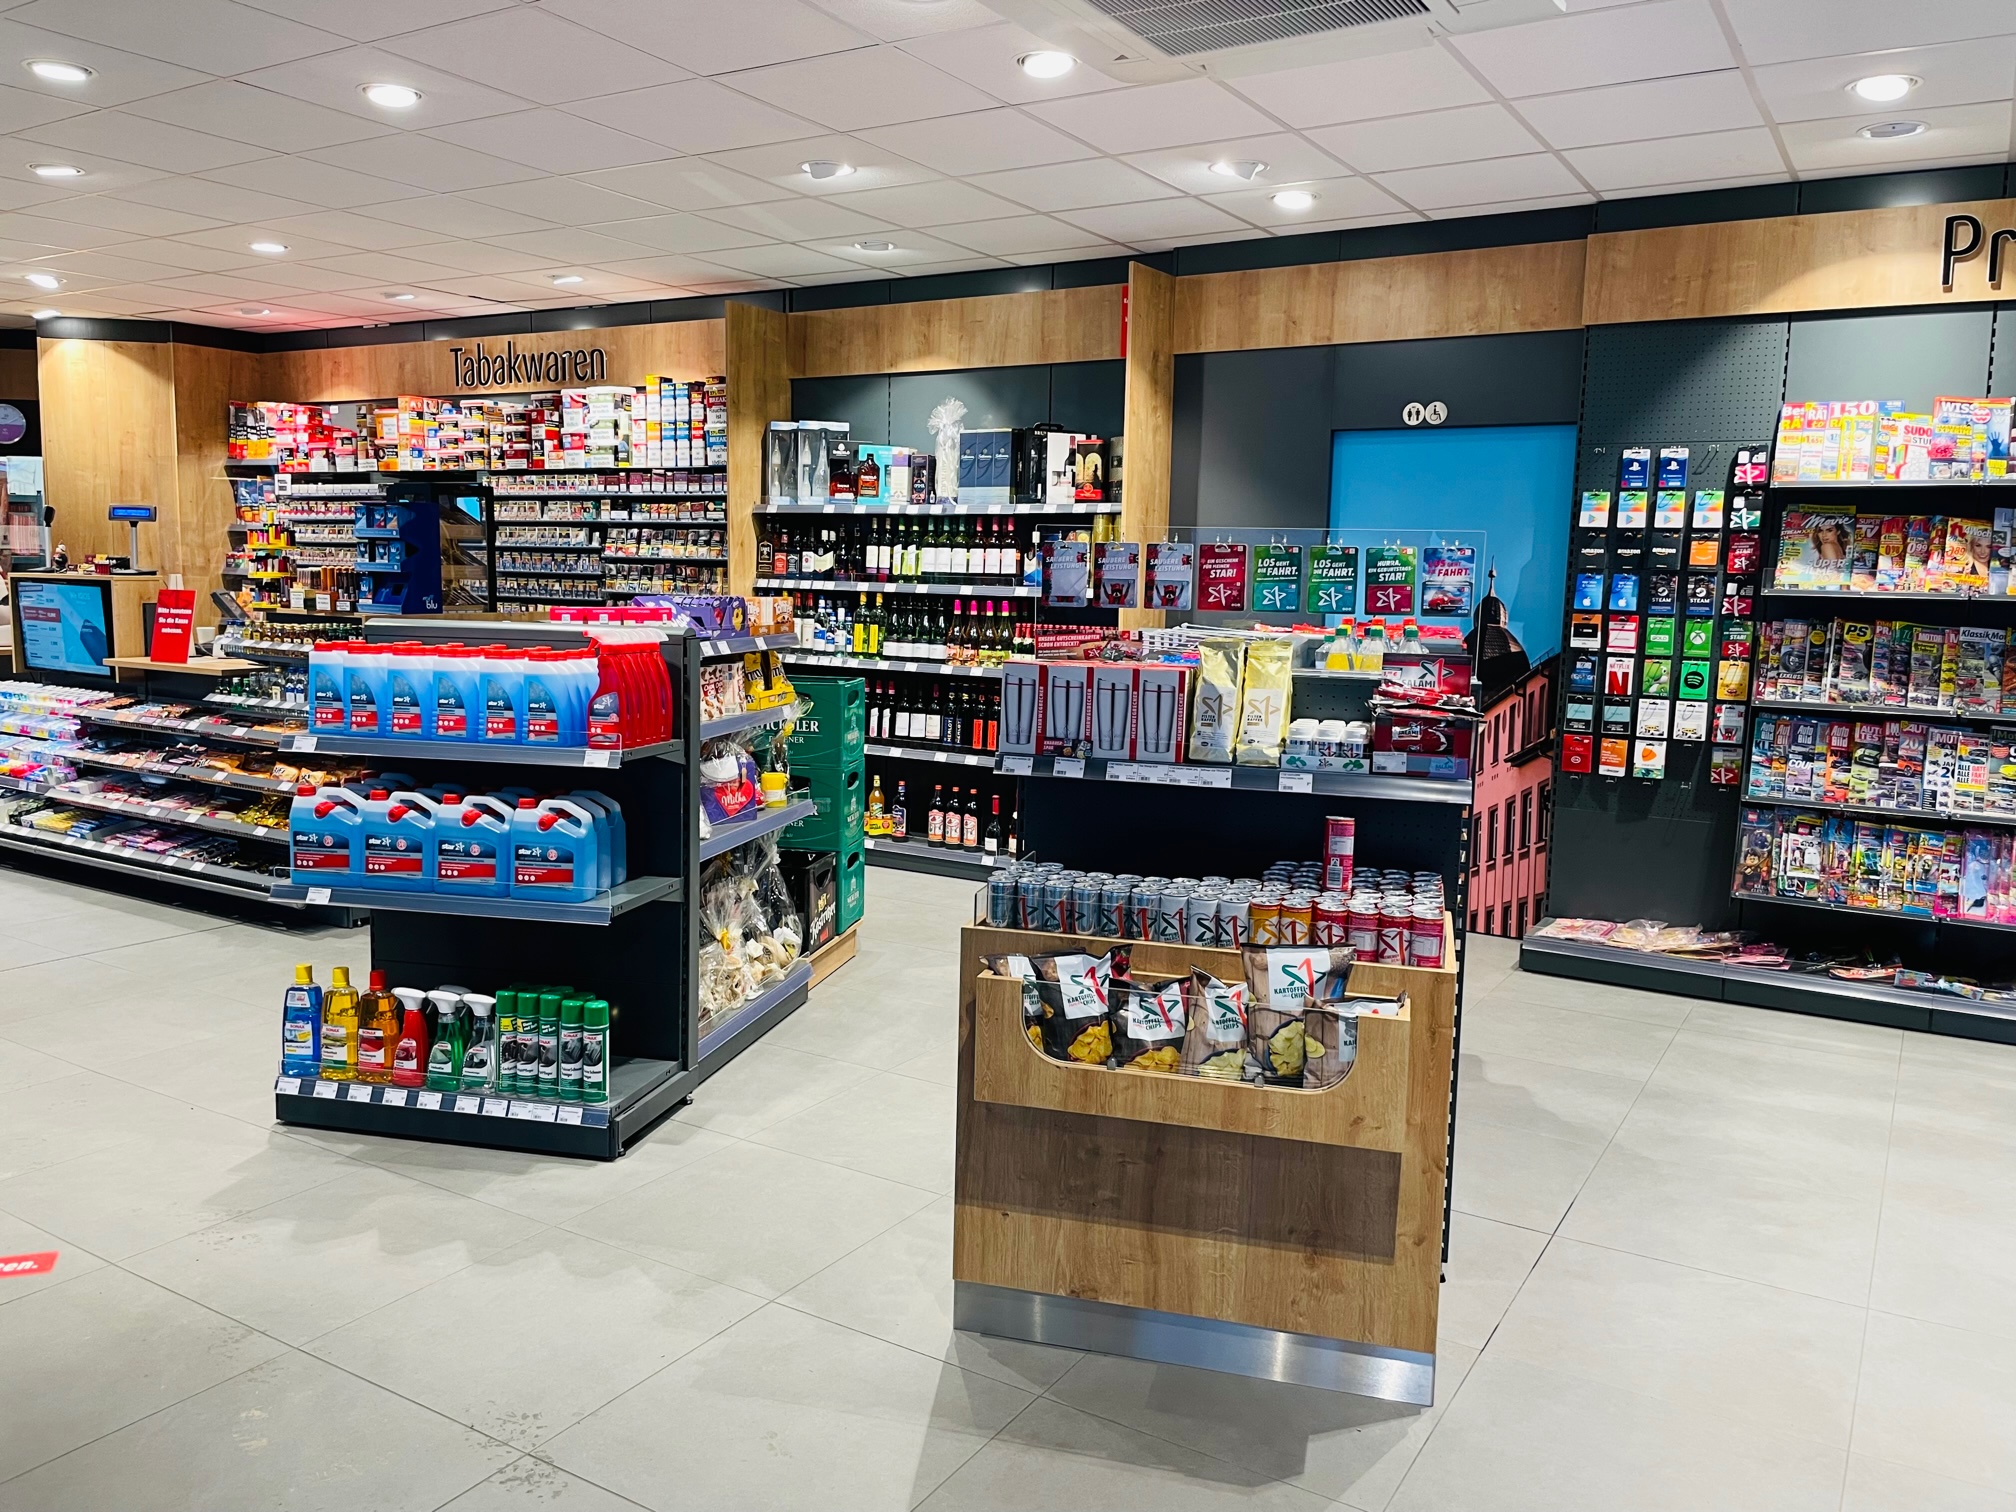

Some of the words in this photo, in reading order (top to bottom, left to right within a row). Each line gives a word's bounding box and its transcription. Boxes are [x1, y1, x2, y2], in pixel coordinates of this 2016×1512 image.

[450, 341, 607, 388] Tabakwaren
[1830, 400, 1876, 417] 150
[1801, 514, 1854, 528] Movie
[1857, 524, 1880, 537] TV
[1258, 558, 1275, 566] LOS
[1210, 569, 1236, 578] STAR!
[1267, 567, 1298, 575] FAHRT.
[1323, 568, 1355, 576] FAHRT.
[1438, 568, 1470, 576] FAHRT.
[1379, 573, 1405, 581] STAR!
[426, 599, 437, 609] blu
[1845, 625, 1870, 637] PS
[1402, 678, 1436, 688] SALAMI
[1761, 723, 1775, 731] Auto
[1798, 725, 1814, 735] Auto
[1831, 726, 1849, 737] Auto
[1761, 732, 1774, 740] Bild
[1798, 735, 1813, 744] Bild
[1832, 737, 1848, 747] Bild
[722, 791, 746, 804] Milka
